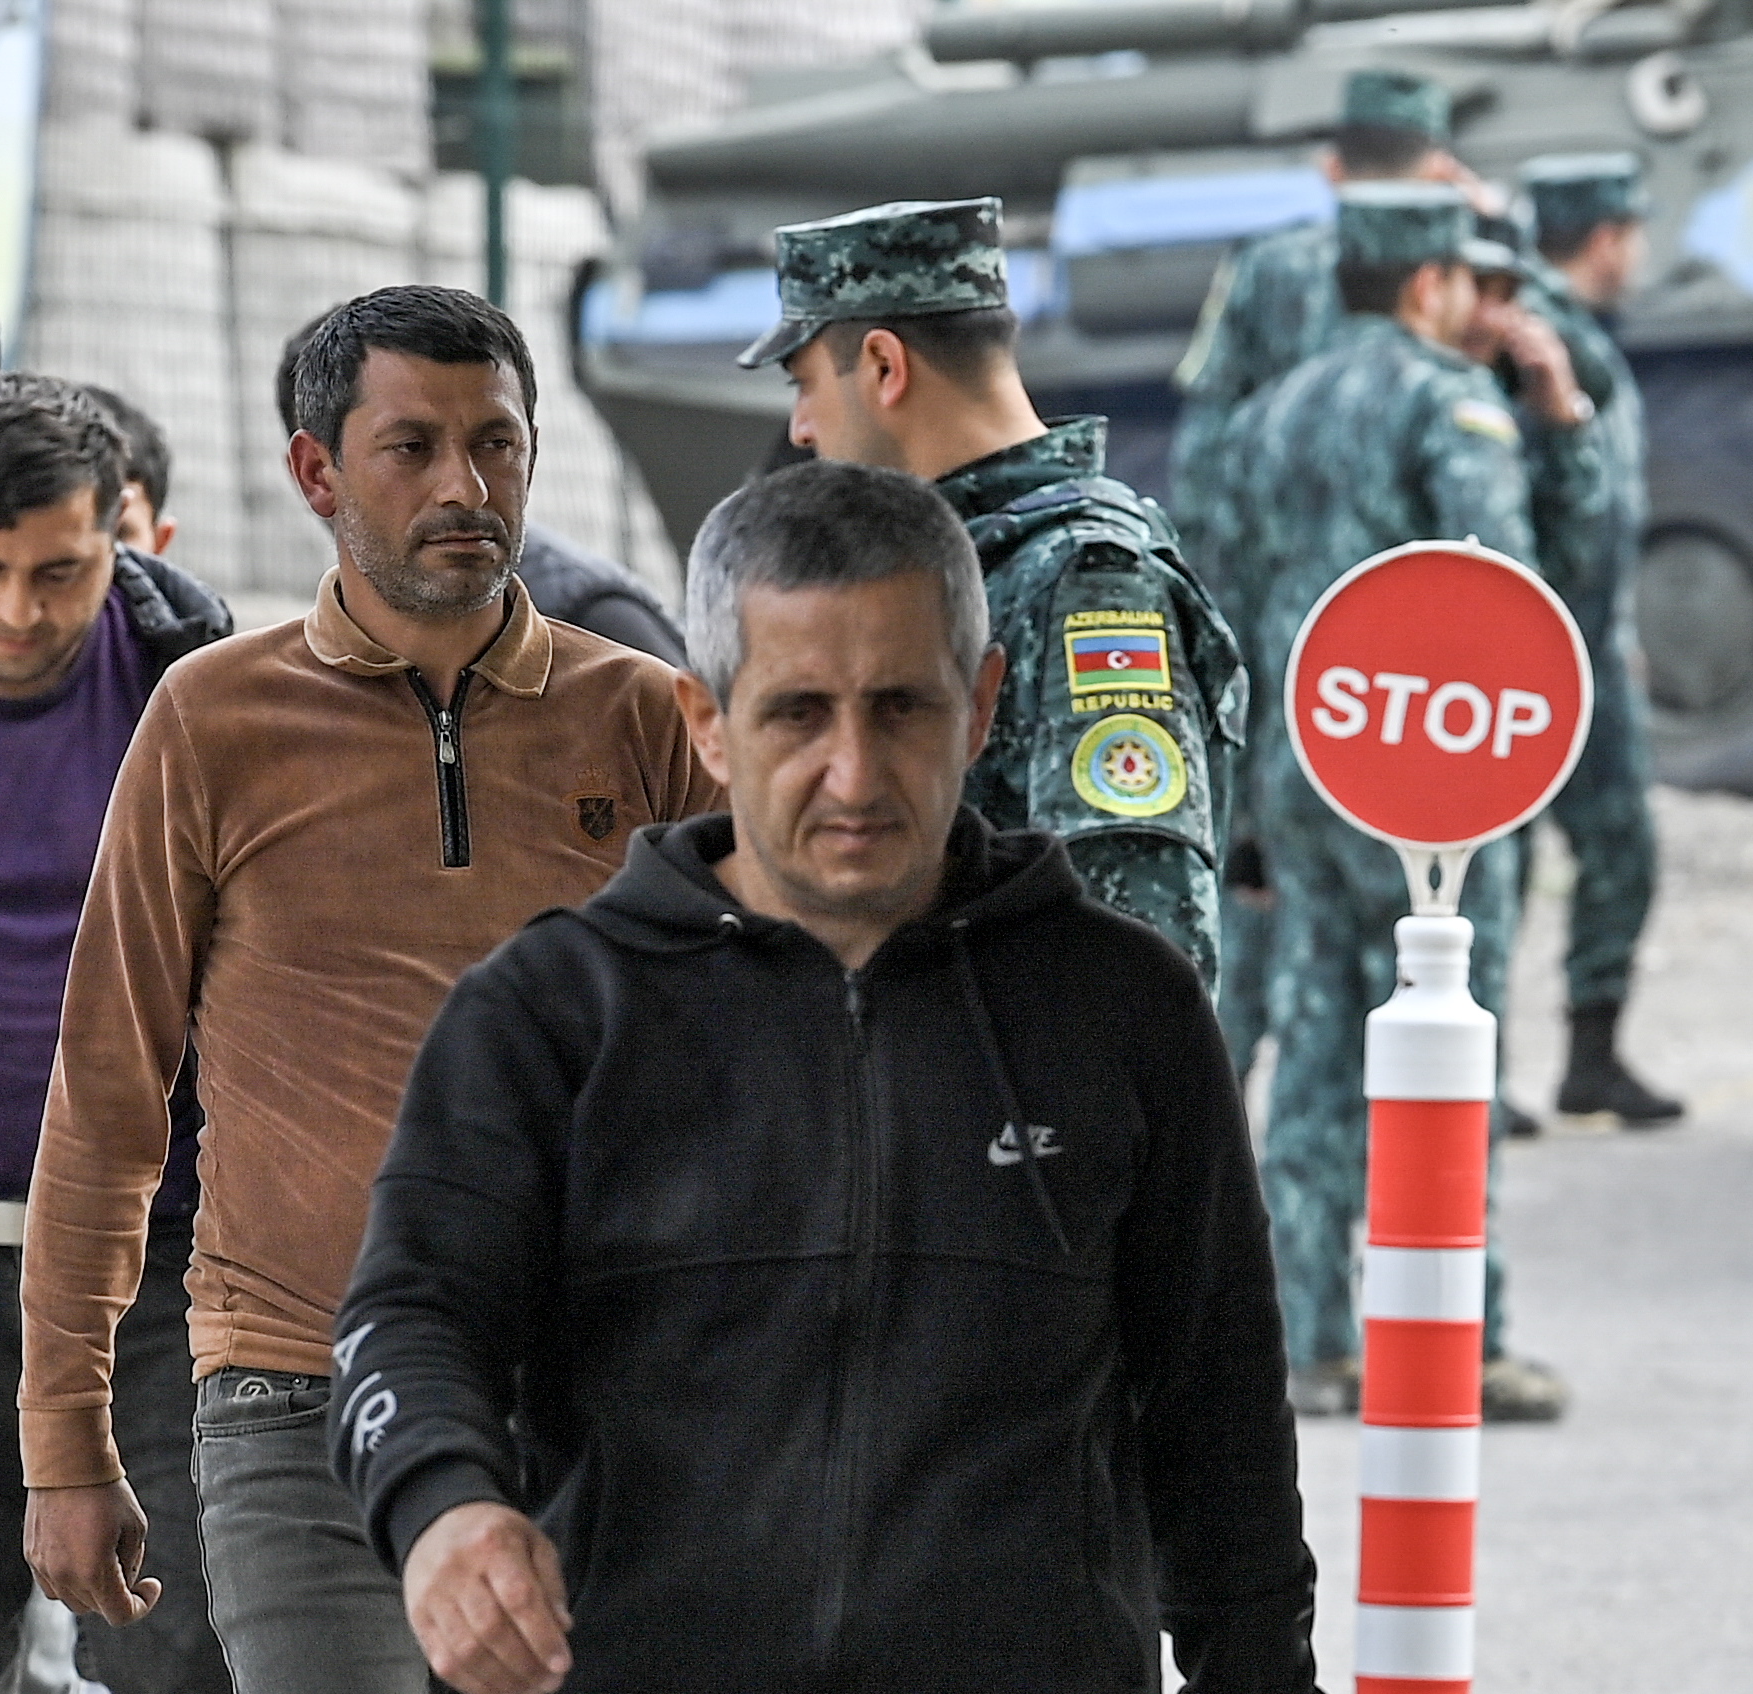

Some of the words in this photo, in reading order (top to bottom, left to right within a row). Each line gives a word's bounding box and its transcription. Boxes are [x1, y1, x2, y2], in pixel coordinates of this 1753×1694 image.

[1064, 610, 1165, 630] AZERBAIJAN
[1071, 692, 1174, 713] REPUBLIC
[1311, 665, 1553, 759] STOP
